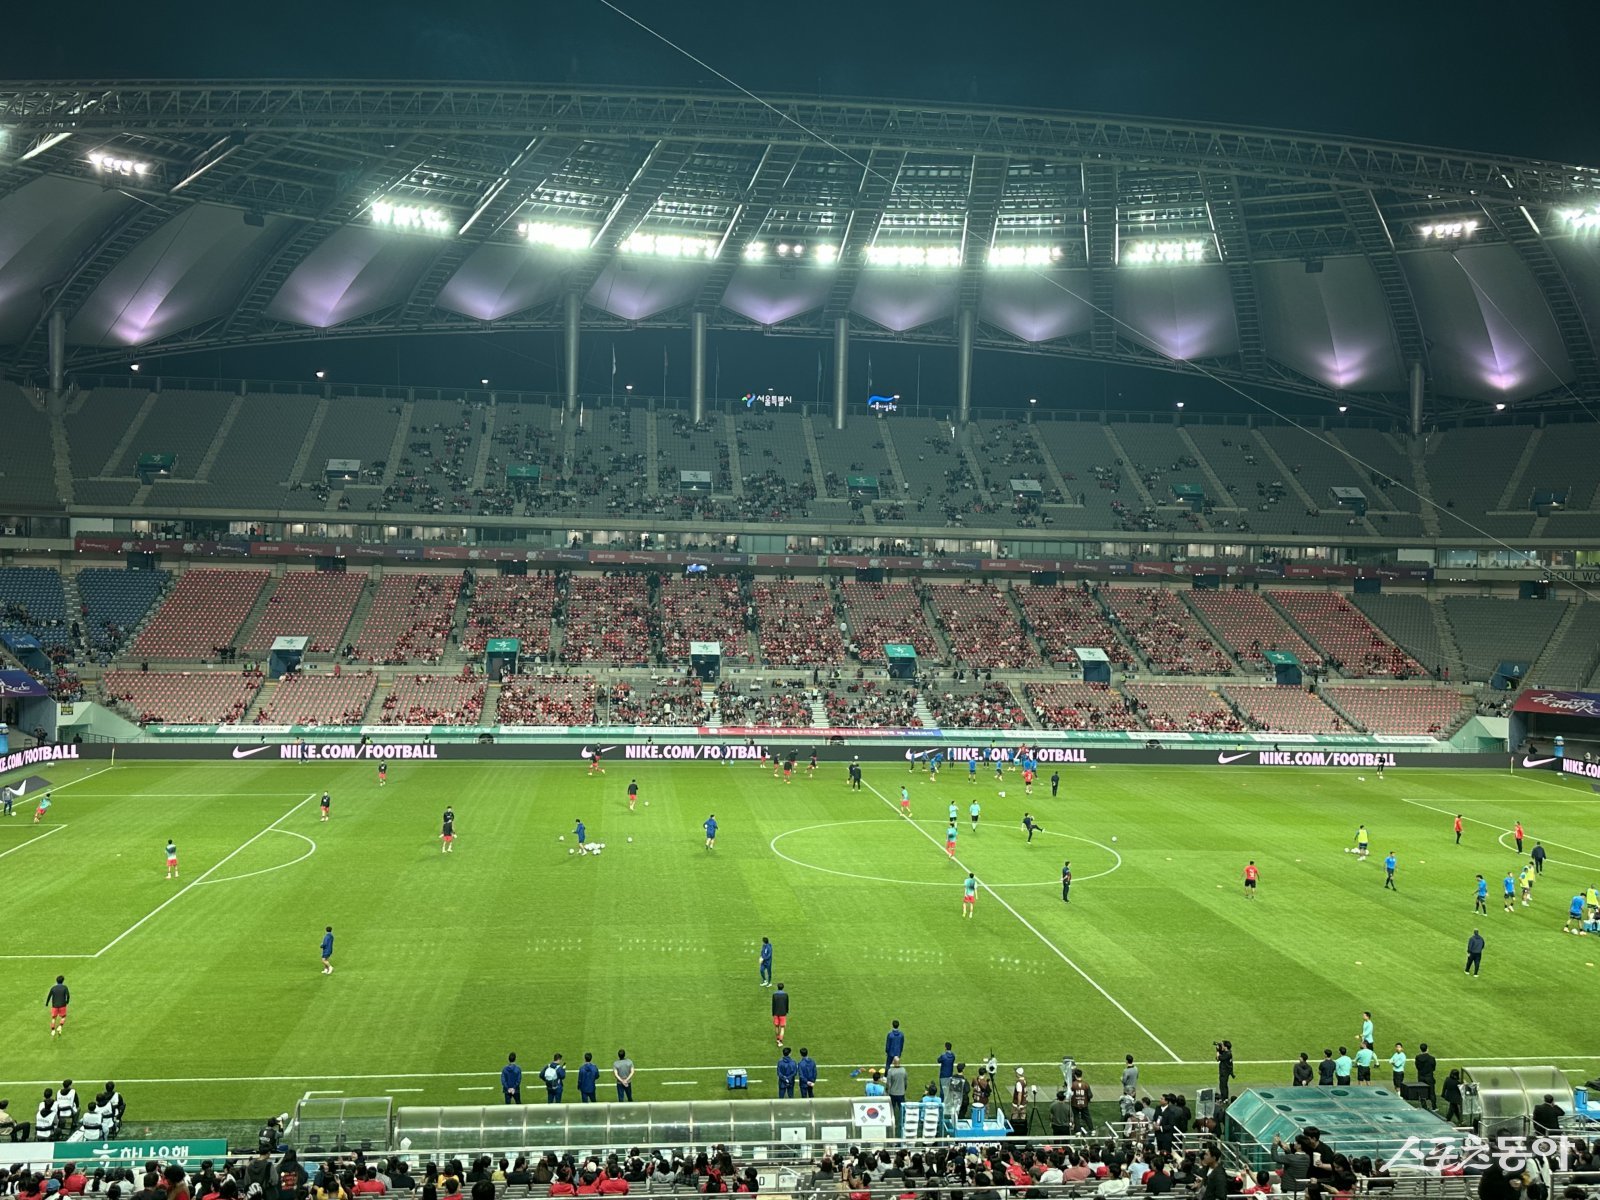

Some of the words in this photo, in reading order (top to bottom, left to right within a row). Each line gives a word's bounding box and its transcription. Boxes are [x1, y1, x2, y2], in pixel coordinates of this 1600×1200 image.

[756, 395, 792, 407] 서울특별시
[1542, 571, 1577, 581] SEOUL
[280, 745, 437, 759] NIKE.COM/FOOTBALL
[1259, 752, 1396, 766] NIKE.COM/FOOTBALL
[1562, 758, 1600, 778] NIKE.CO
